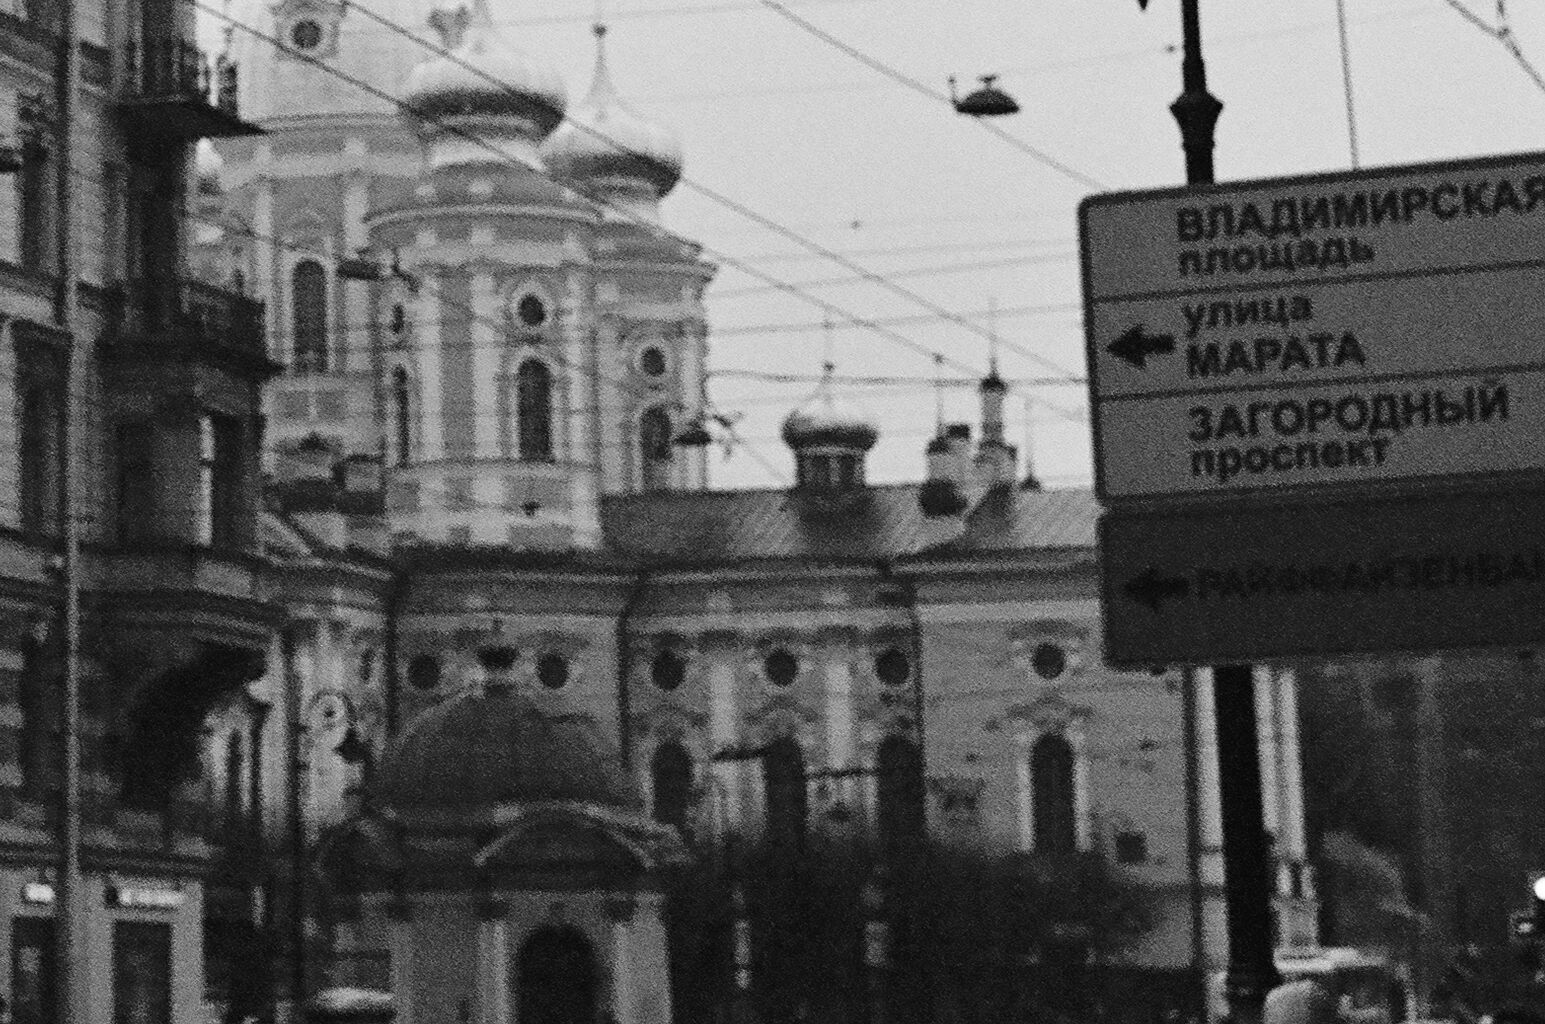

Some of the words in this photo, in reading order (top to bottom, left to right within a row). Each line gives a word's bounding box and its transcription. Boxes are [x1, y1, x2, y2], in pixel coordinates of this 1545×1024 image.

[1176, 175, 1545, 243] ВЛАДИМИРСКАЯ
[1177, 237, 1375, 276] площадь
[1182, 294, 1313, 336] улица
[1186, 331, 1366, 378] МАРАТА
[1188, 377, 1510, 443] ЗАГОРОДНЫЙ
[1190, 437, 1390, 482] проспект
